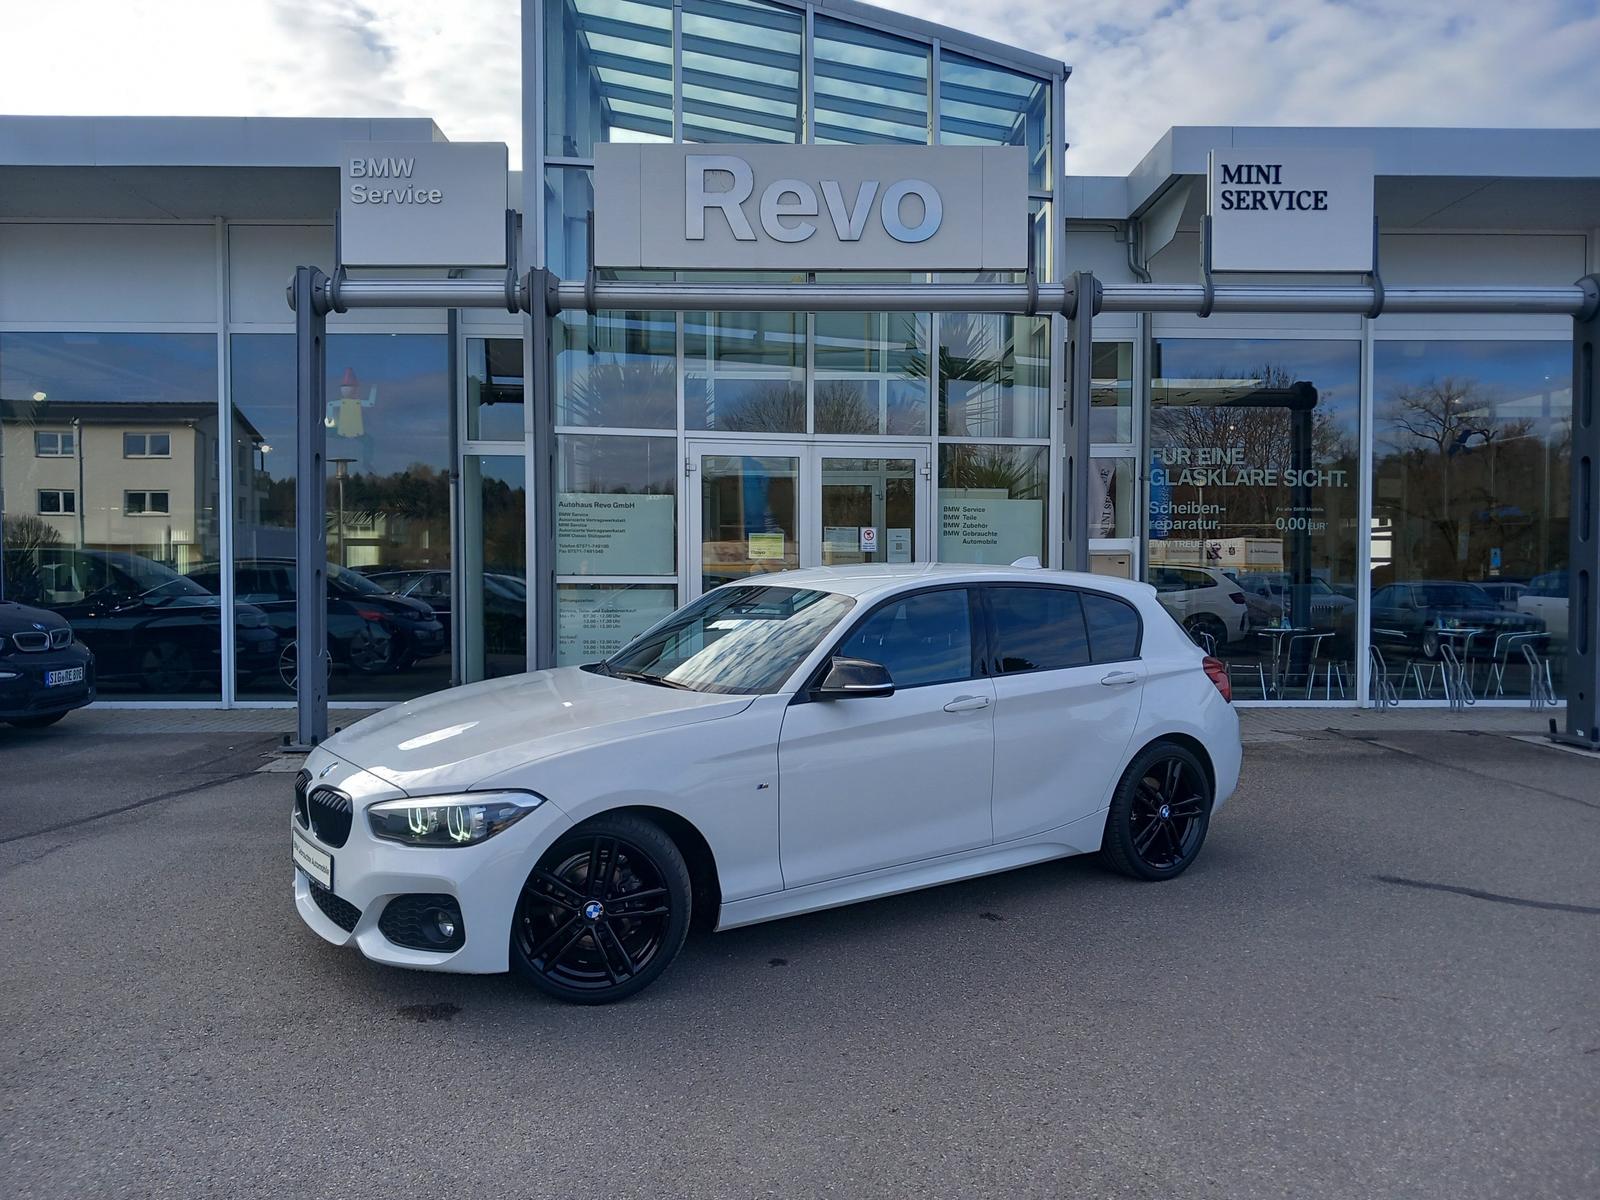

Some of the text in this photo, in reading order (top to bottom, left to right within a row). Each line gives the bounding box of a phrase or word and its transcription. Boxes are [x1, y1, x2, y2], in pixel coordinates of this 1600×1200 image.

[350, 157, 415, 178] BMW
[1221, 164, 1282, 185] MINI
[350, 184, 443, 204] Service
[685, 155, 943, 243] Revo
[1221, 190, 1328, 211] SERVICE
[1150, 444, 1245, 465] FÜR EINE
[1150, 468, 1348, 488] GLASKLARE SICHT.
[558, 501, 635, 509] Autohaus Revo GmbH
[1150, 501, 1226, 514] Scheiben-
[1150, 518, 1221, 532] reparatur.
[1275, 517, 1306, 533] 0,00
[1174, 540, 1203, 548] TREUE
